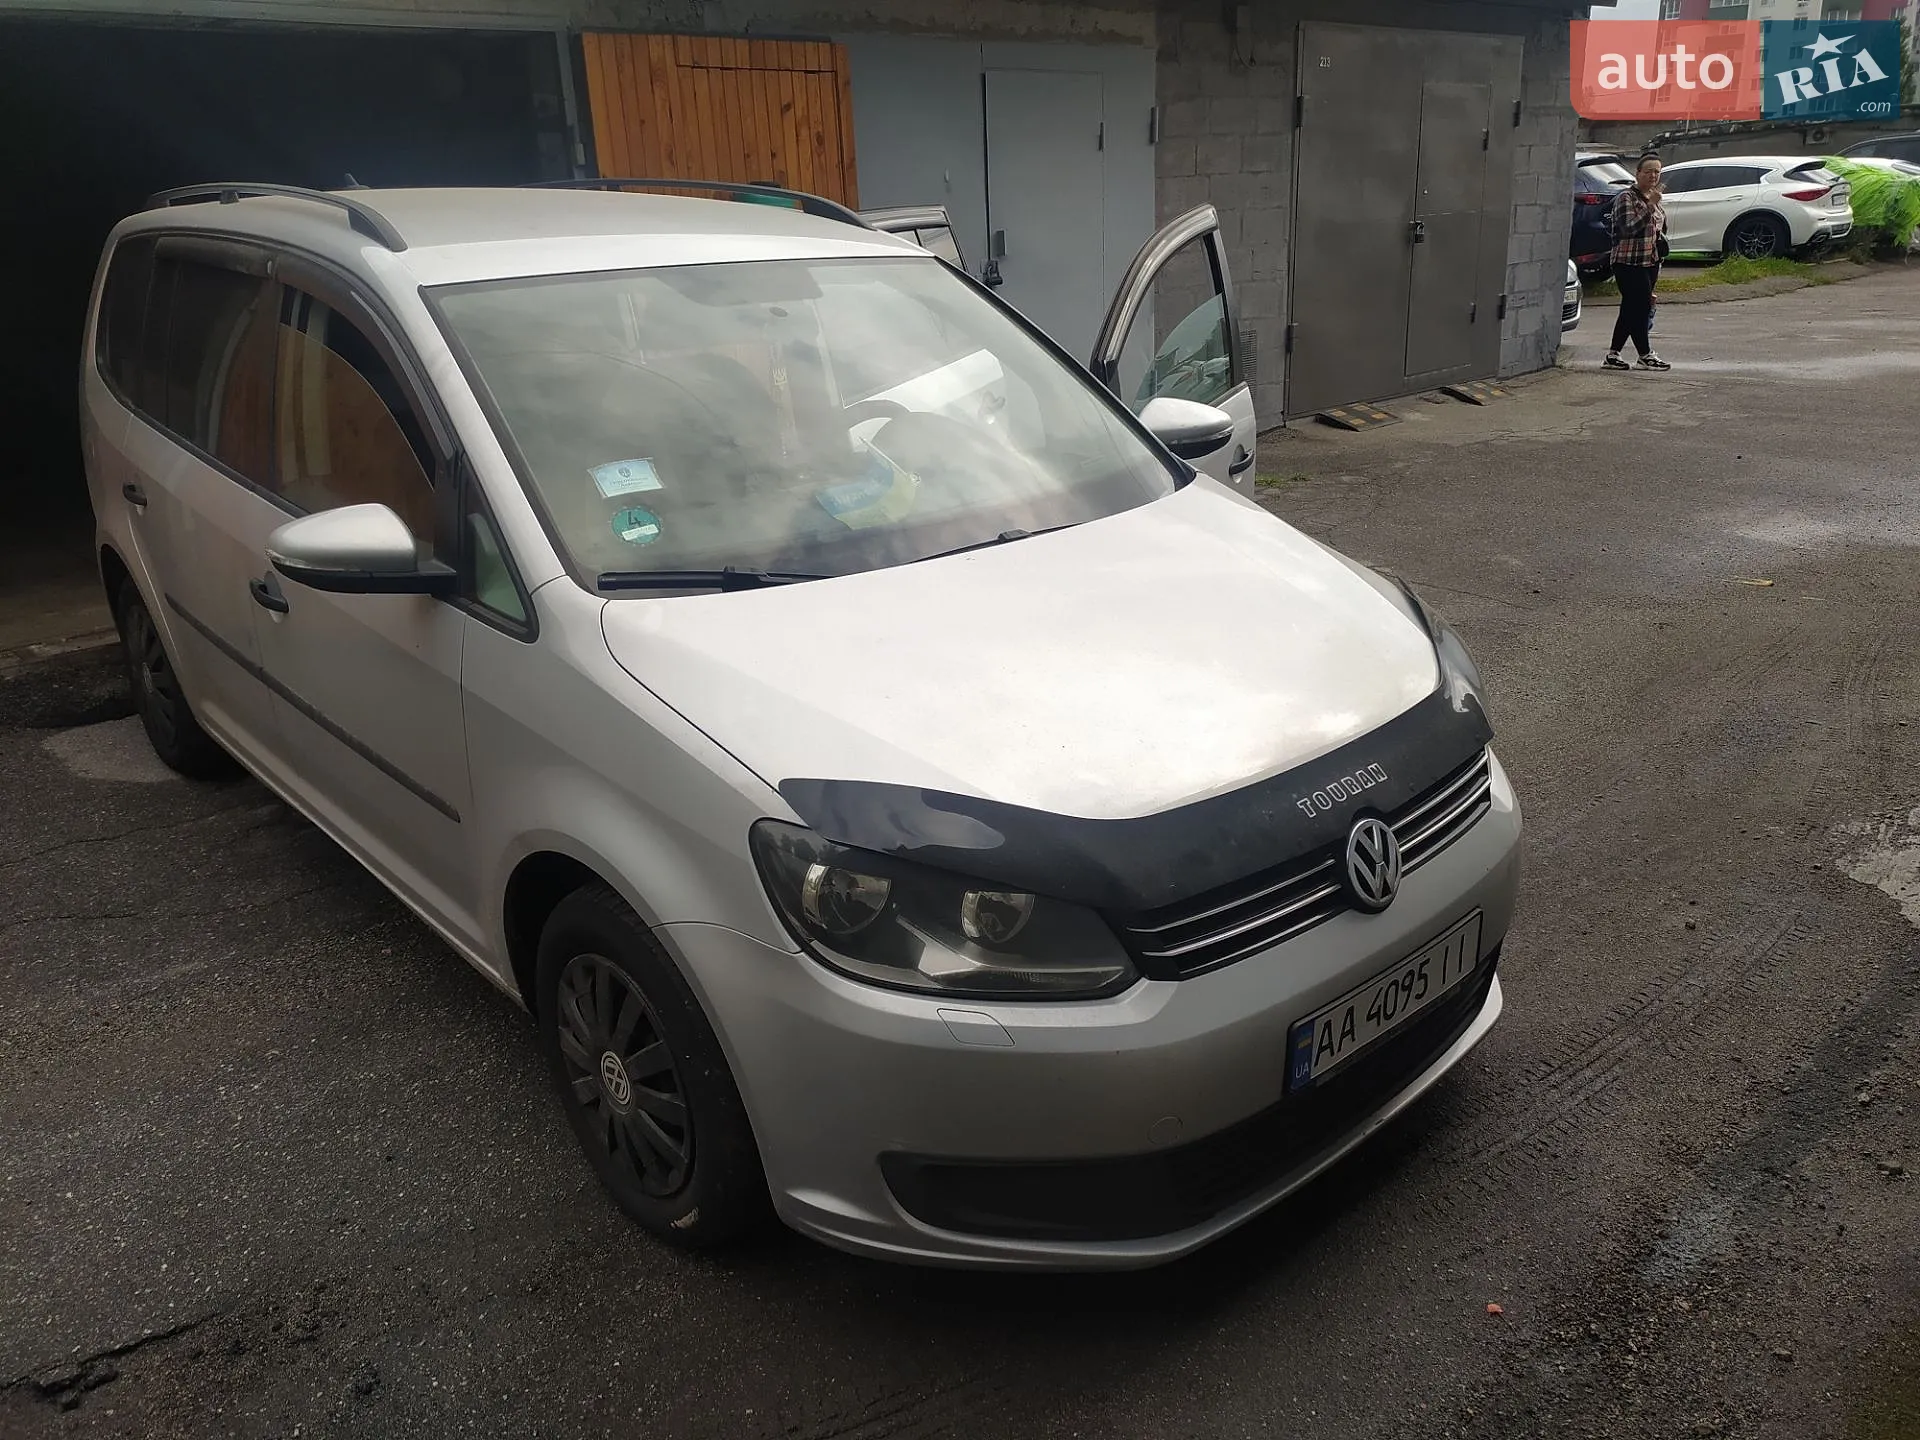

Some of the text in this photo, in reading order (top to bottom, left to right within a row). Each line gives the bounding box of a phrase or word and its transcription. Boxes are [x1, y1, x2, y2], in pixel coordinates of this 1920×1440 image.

[1319, 56, 1331, 68] 213
[1296, 762, 1388, 818] TOURAN
[1314, 1005, 1356, 1067] AA
[1366, 957, 1431, 1028] 4095
[1295, 1064, 1309, 1078] UA
